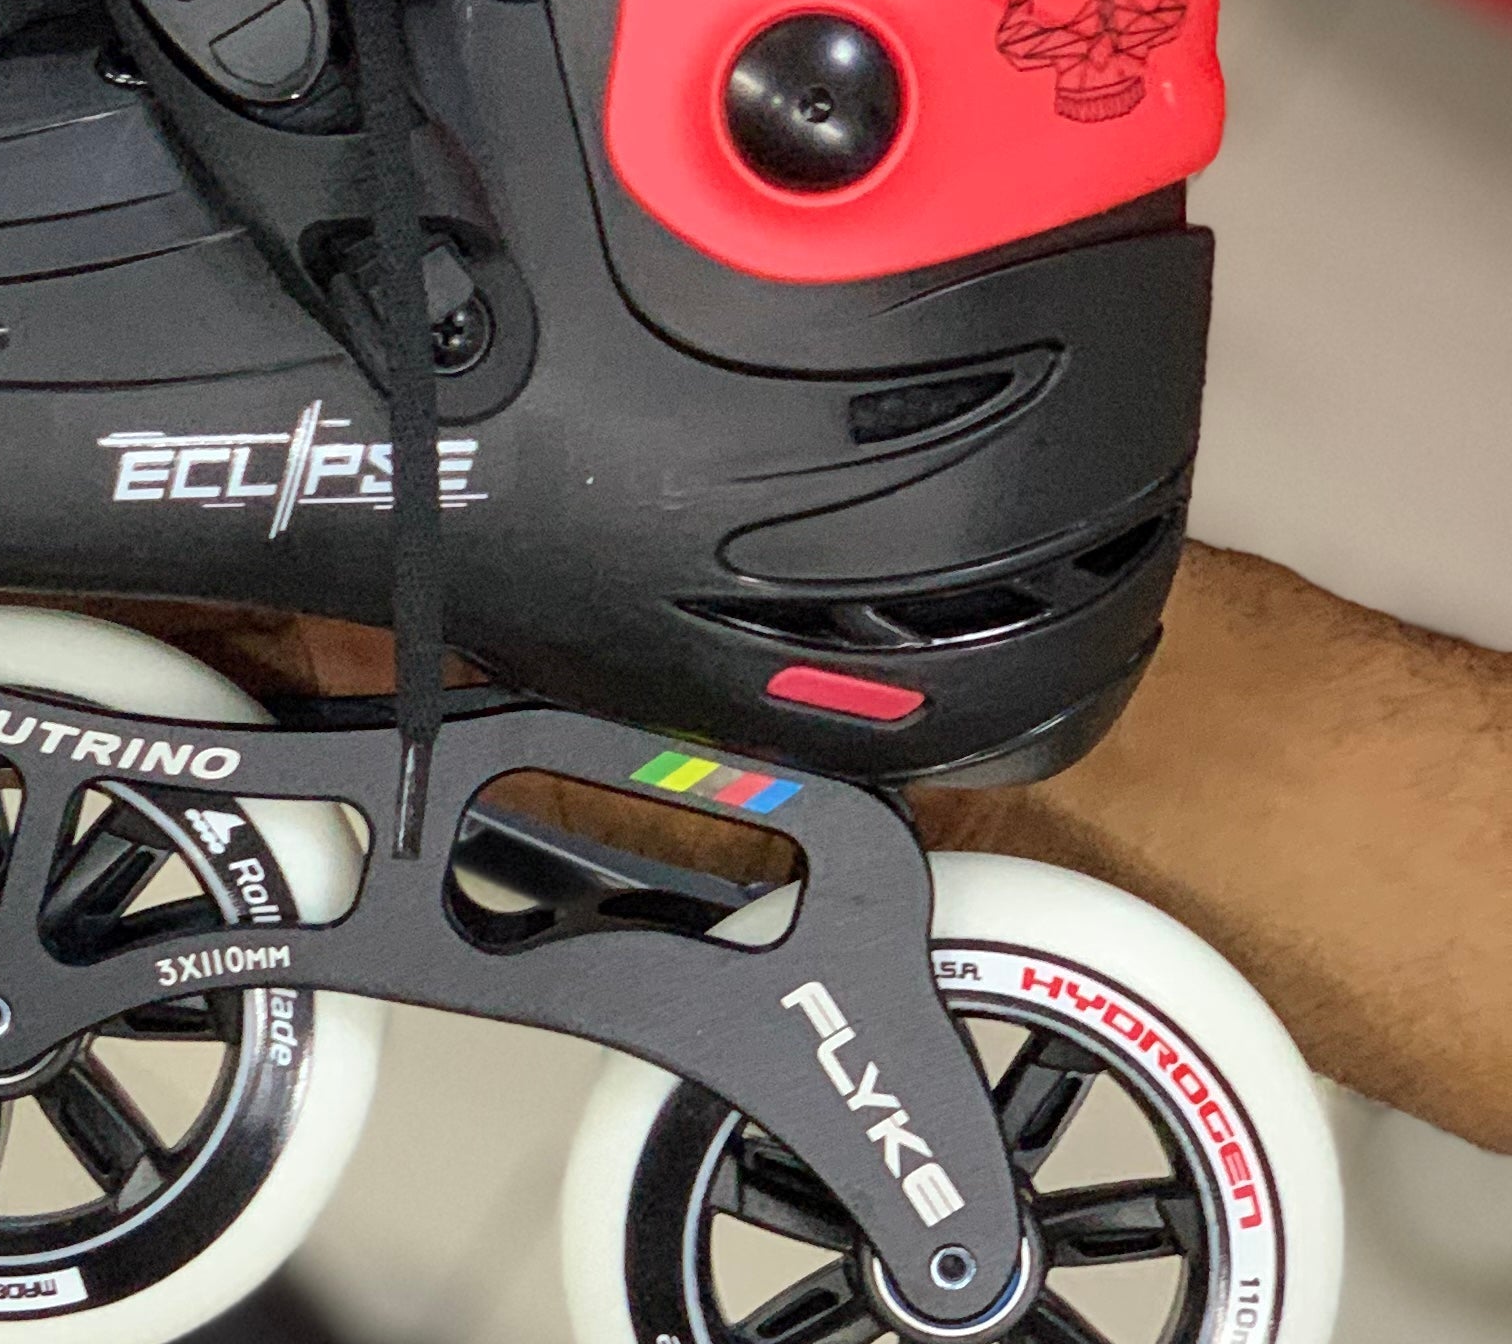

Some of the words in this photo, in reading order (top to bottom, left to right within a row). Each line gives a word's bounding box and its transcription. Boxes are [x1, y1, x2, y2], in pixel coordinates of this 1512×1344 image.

[97, 400, 487, 539] ECLIPSE
[155, 945, 291, 986] 3X110MM
[780, 981, 966, 1228] FLYKE
[1021, 967, 1263, 1230] HYDROGEN
